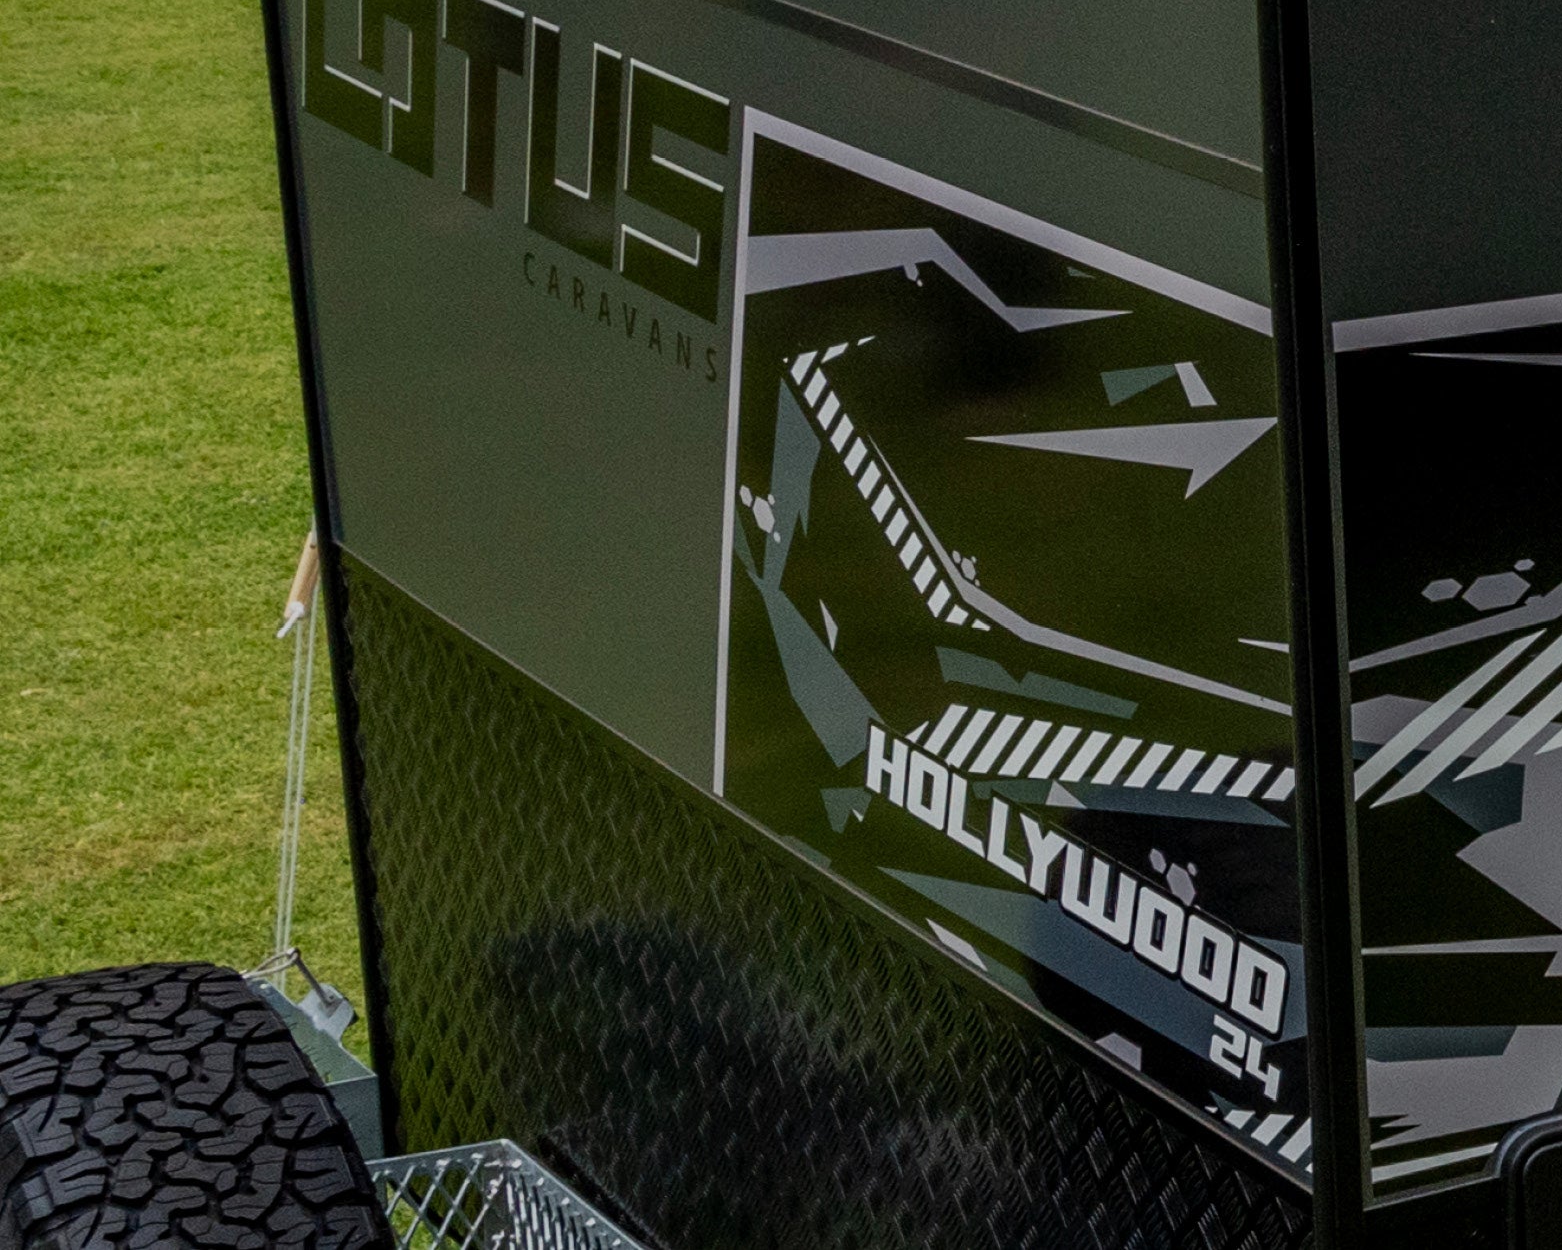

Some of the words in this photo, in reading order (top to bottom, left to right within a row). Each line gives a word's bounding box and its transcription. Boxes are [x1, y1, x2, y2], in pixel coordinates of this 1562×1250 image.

[522, 252, 718, 382] CARAVANS
[865, 723, 1288, 1036] HOLLYWOOD
[1208, 1014, 1281, 1102] 24
